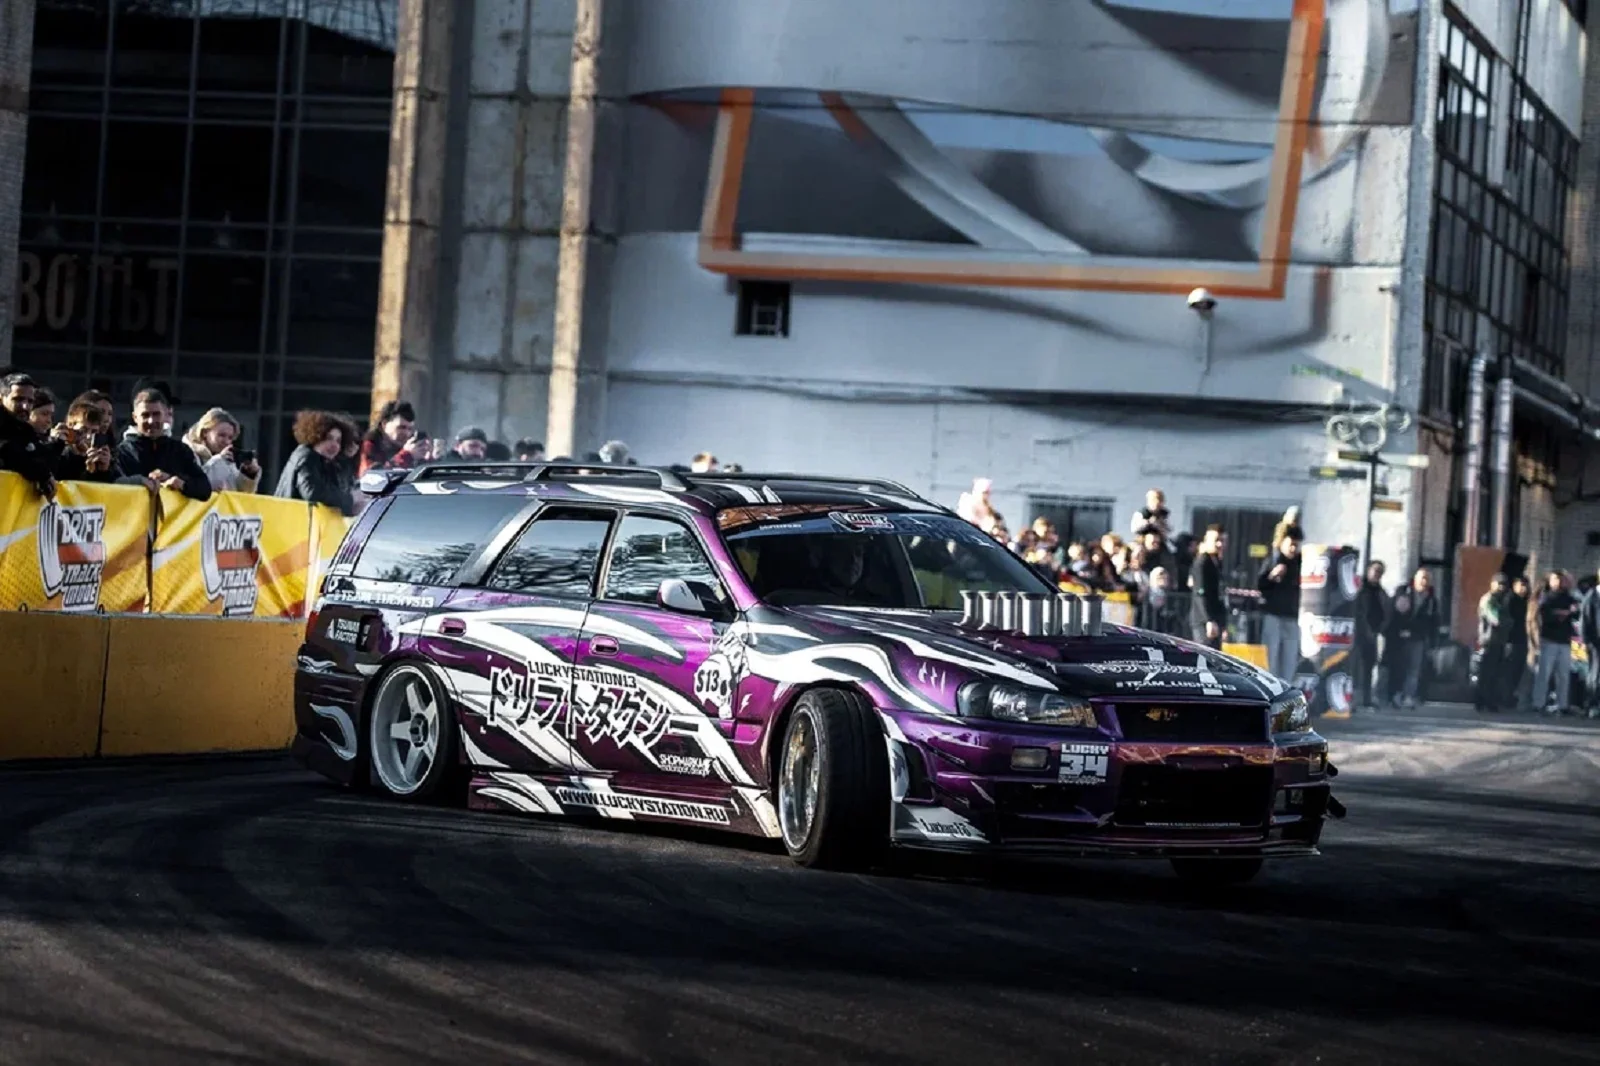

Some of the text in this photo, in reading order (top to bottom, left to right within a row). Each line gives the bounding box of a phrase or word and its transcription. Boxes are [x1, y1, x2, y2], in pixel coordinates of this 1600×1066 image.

[61, 510, 103, 543] DRIFT
[218, 519, 261, 551] DRIFT
[527, 660, 637, 688] LUCKYSTATION13
[696, 669, 720, 693] S13
[1061, 743, 1109, 755] LUCKY
[1059, 754, 1109, 777] 34
[559, 789, 728, 822] WWW.LUCKYSTATION.RU
